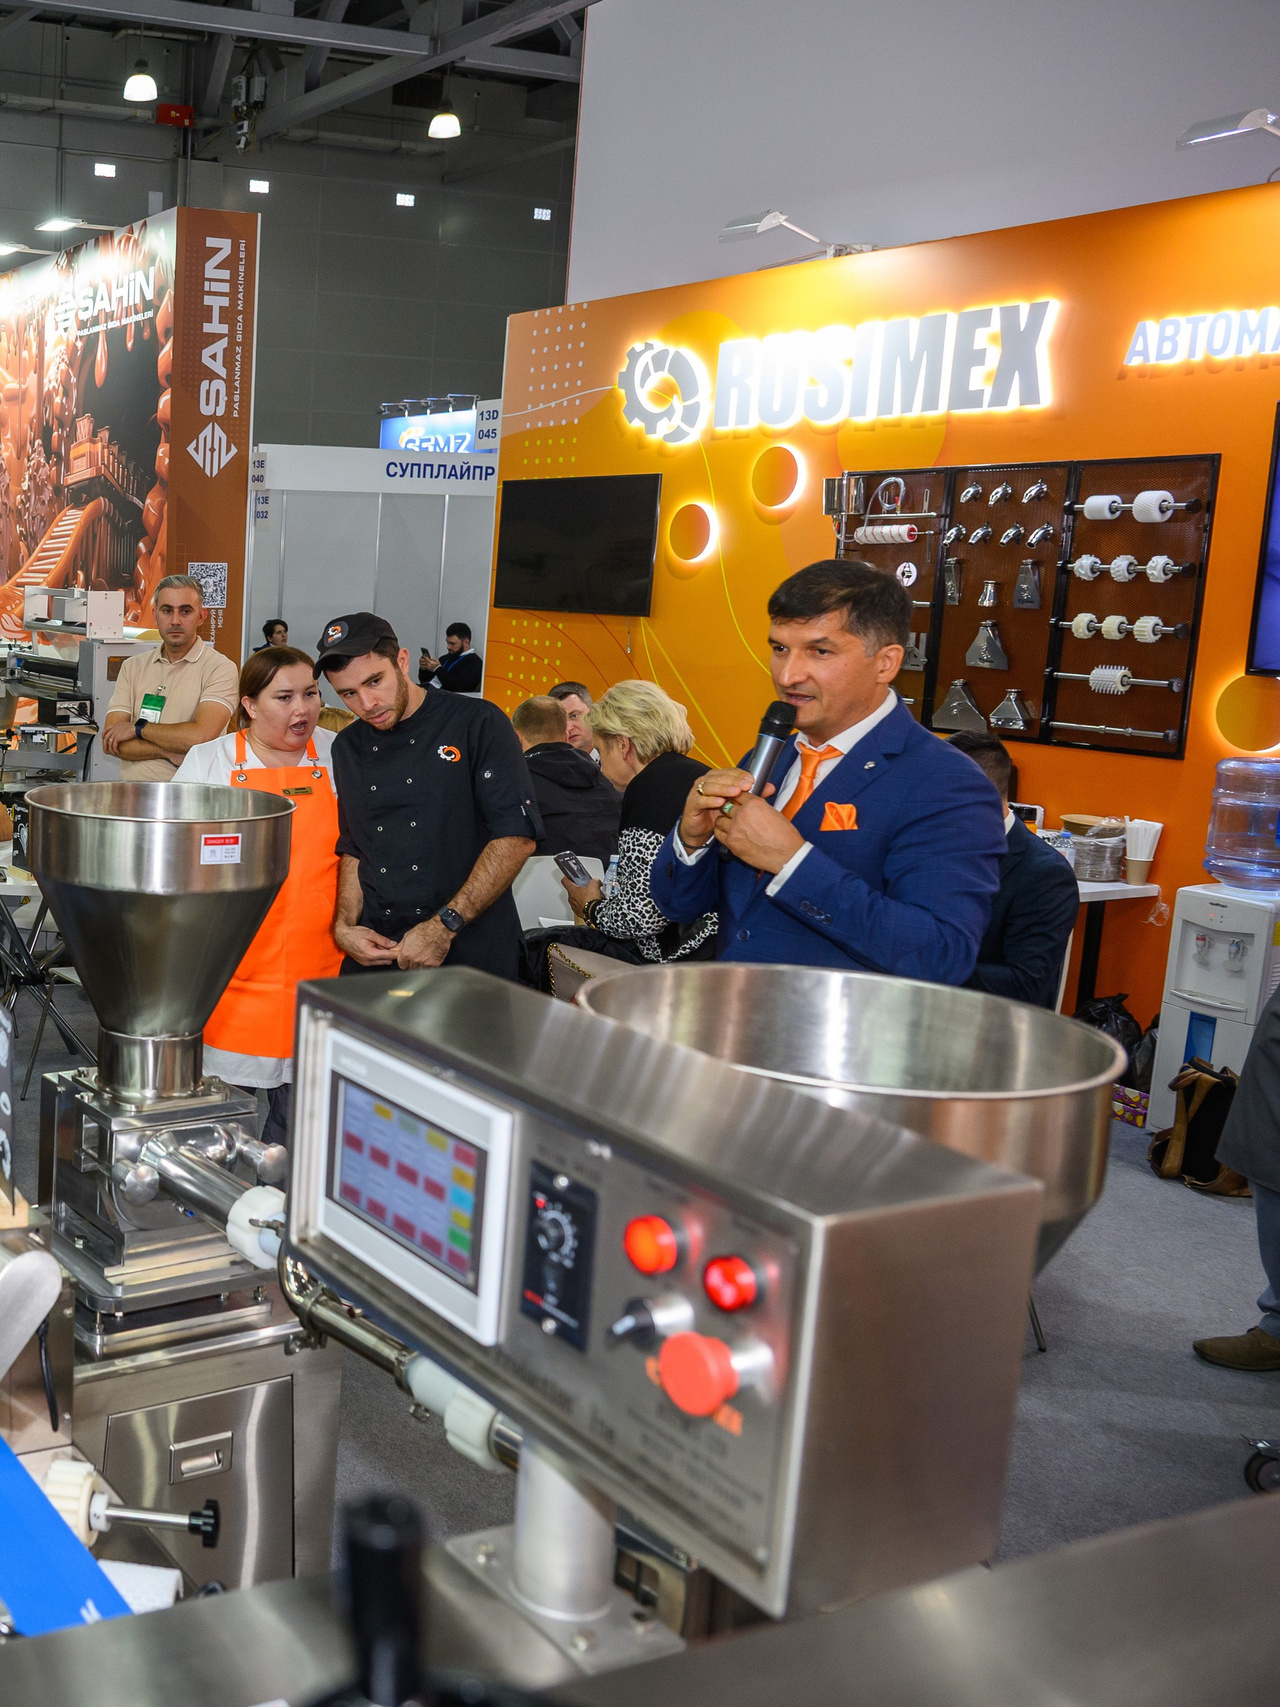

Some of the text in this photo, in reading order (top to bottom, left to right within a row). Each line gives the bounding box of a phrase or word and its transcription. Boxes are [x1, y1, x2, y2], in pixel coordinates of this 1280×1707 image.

[712, 301, 1051, 430] RUSIMEX
[479, 410, 499, 421] 13D
[478, 428, 497, 440] 045
[252, 460, 265, 468] 13E
[386, 461, 495, 481] СУППЛАЙПР
[251, 475, 264, 483] 040
[257, 496, 269, 504] 13E
[256, 511, 269, 519] 032
